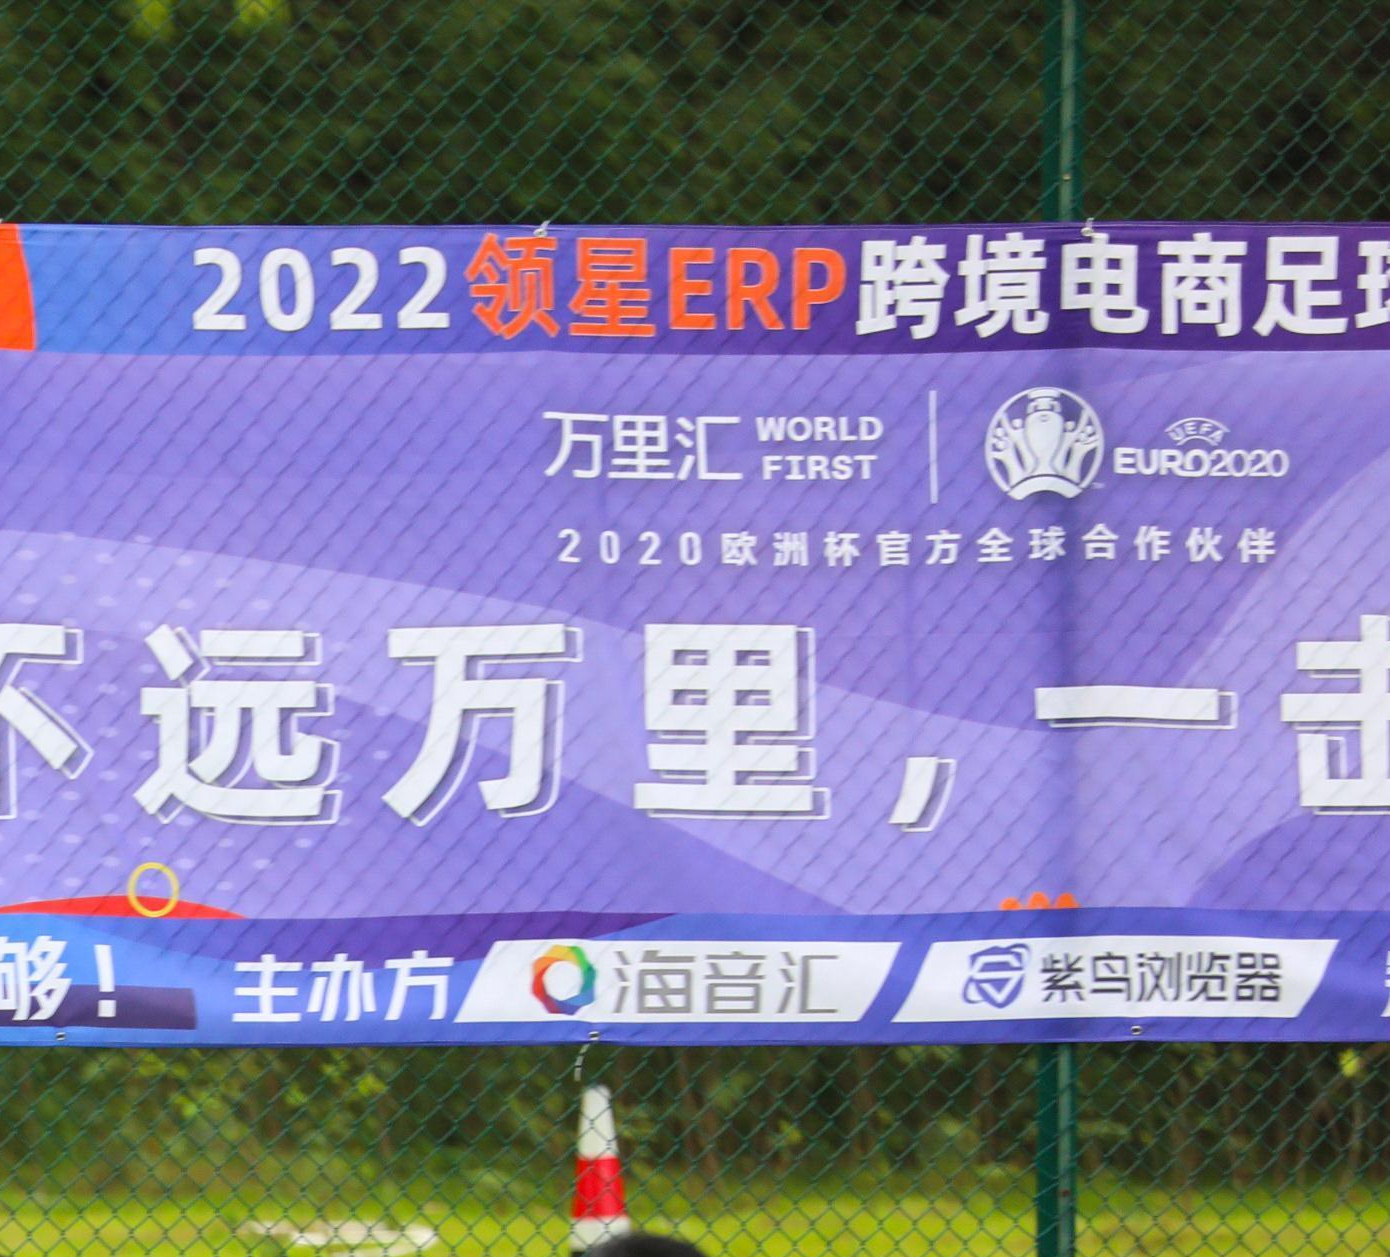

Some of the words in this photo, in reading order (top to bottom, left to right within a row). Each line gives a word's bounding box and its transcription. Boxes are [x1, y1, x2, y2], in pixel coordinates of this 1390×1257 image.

[543, 411, 742, 481] 万里汇
[756, 416, 883, 442] WORLD
[1169, 421, 1224, 442] UEFA
[763, 455, 877, 481] FIRST
[1113, 447, 1290, 477] EURO2020
[557, 523, 1277, 567] 2020欧洲杯官方全球合作伙伴
[232, 951, 454, 1024] 主办方
[612, 949, 839, 1015] 海音汇
[1040, 951, 1282, 1004] 紫鸟浏览器
